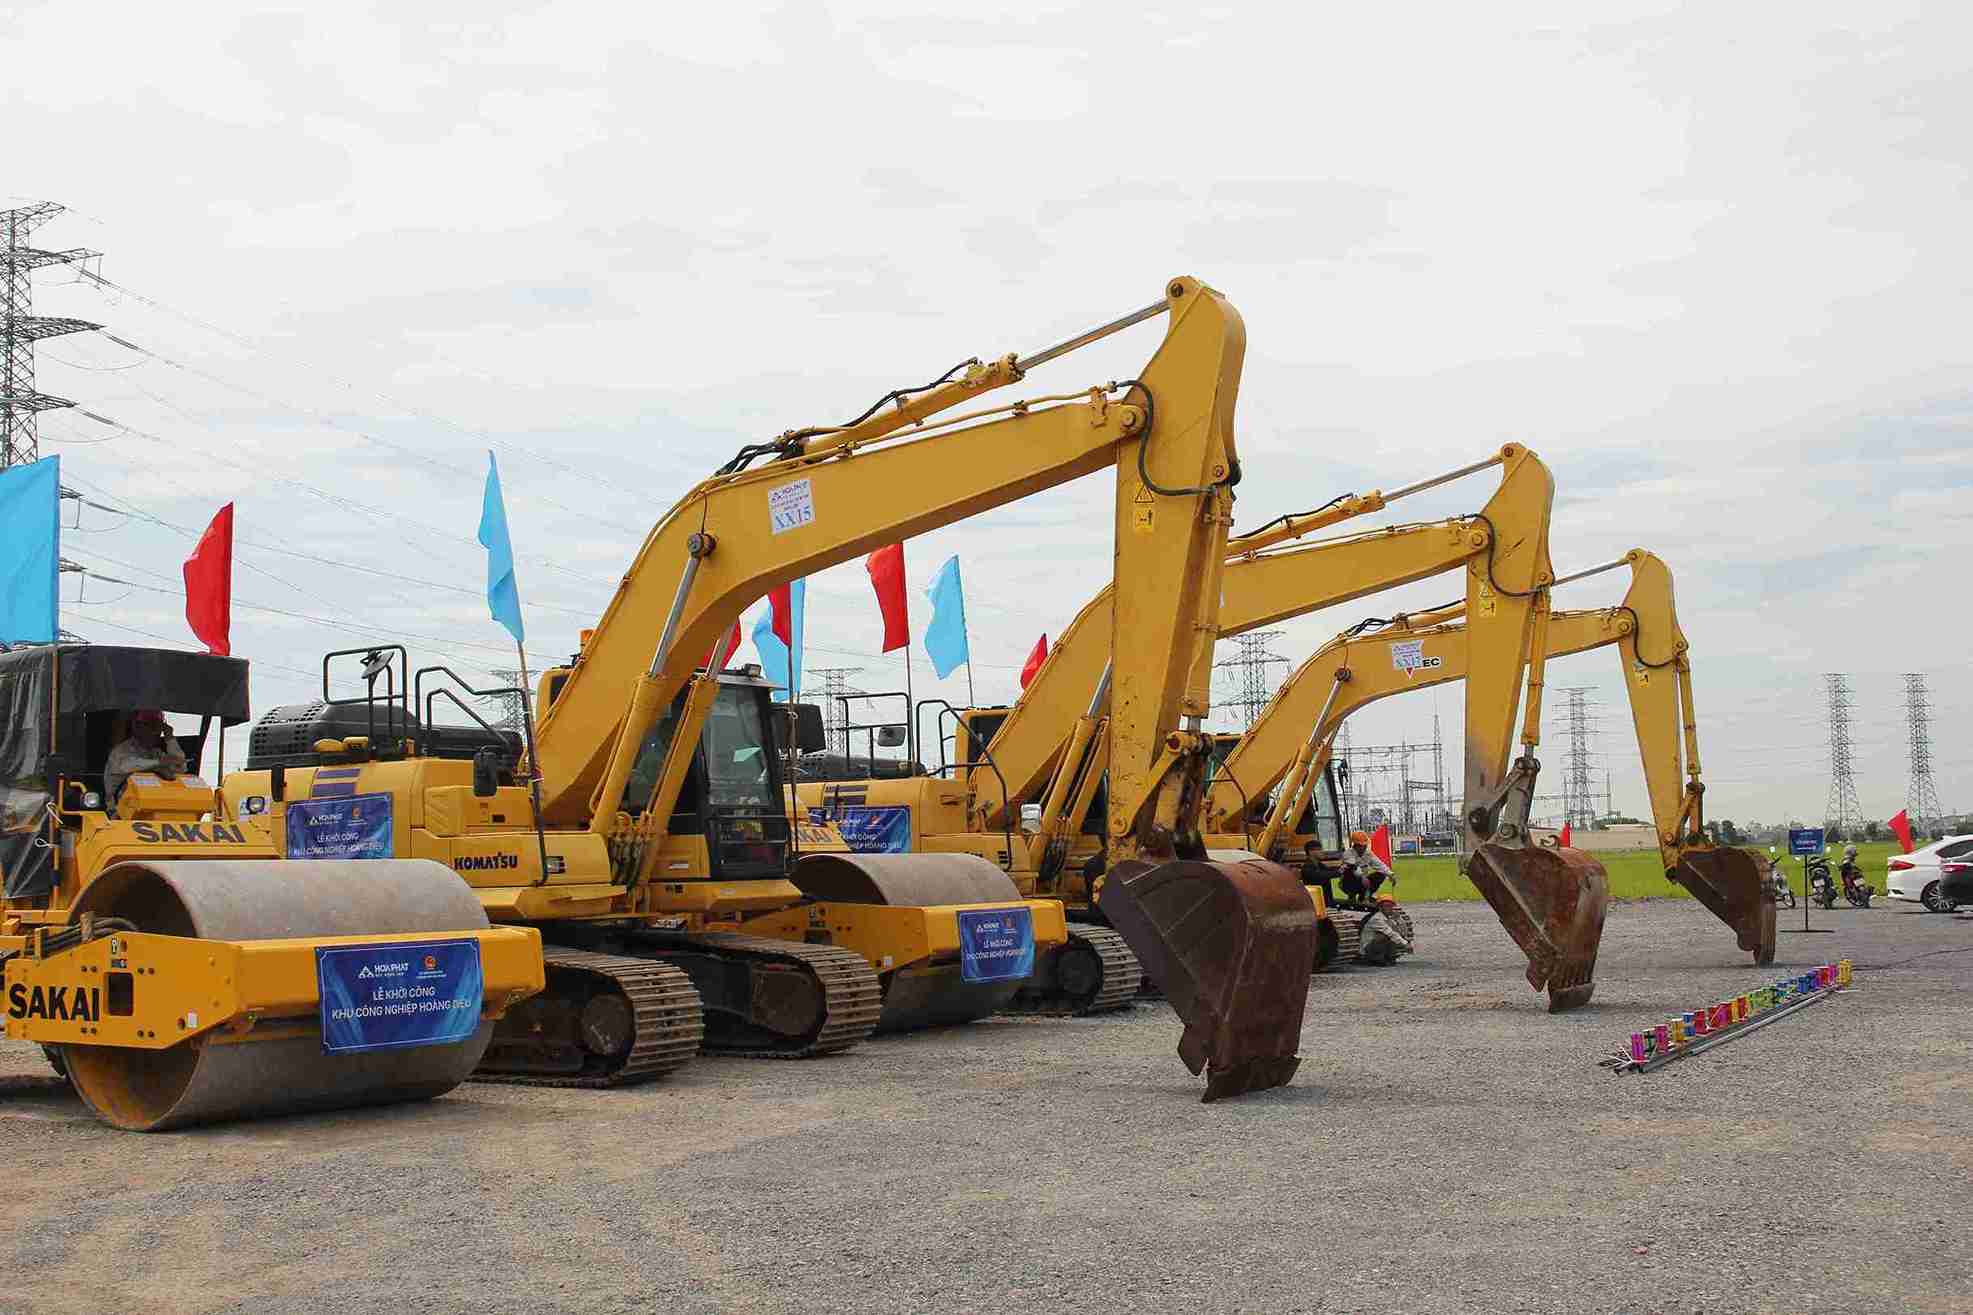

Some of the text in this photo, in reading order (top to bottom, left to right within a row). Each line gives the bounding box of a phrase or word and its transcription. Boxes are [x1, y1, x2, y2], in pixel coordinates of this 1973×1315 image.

[1415, 657, 1440, 668] EC
[131, 821, 247, 844] SAKAI
[453, 852, 518, 871] KOMATSU
[408, 985, 436, 999] CÔNG
[8, 983, 100, 1022] SAKAI
[331, 1006, 354, 1020] KHU
[355, 1005, 384, 1018] CÔNG
[384, 1002, 418, 1016] NGHIỆP
